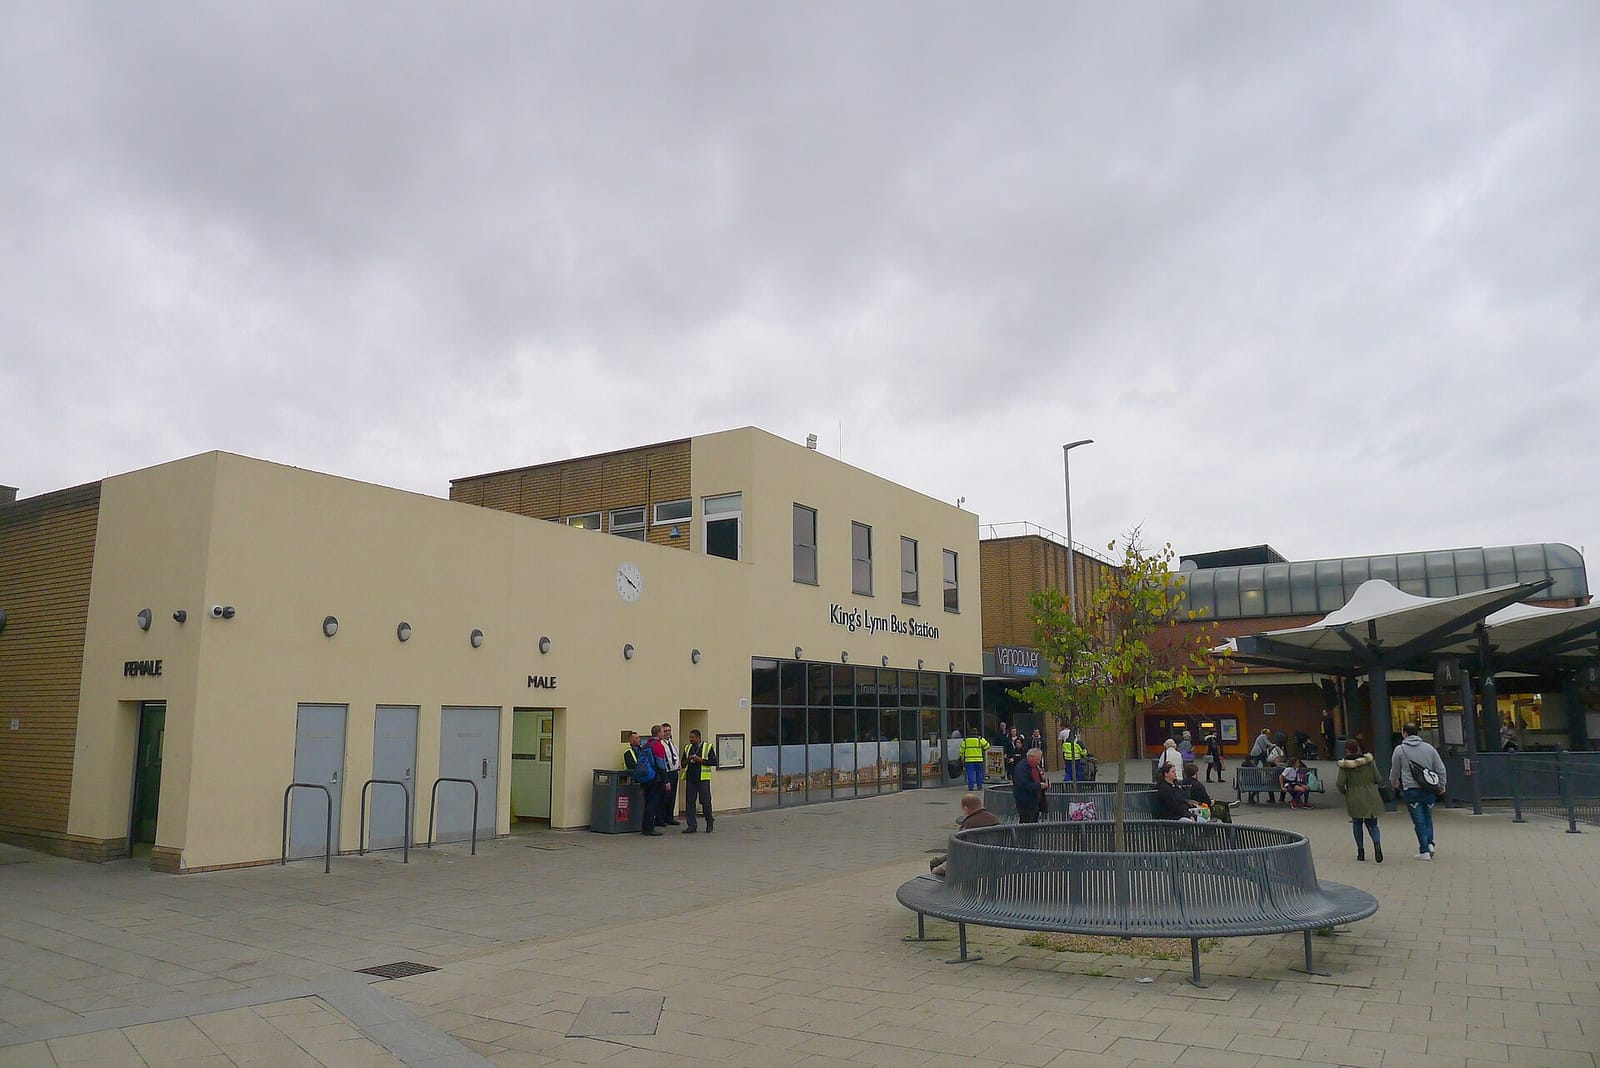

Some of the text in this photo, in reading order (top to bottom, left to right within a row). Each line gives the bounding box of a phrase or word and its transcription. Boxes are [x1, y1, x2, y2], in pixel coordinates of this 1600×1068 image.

[830, 603, 939, 639] King's Lynn Bus Station
[124, 659, 162, 676] FEMALE
[528, 675, 557, 689] MALE
[1485, 677, 1494, 687] A
